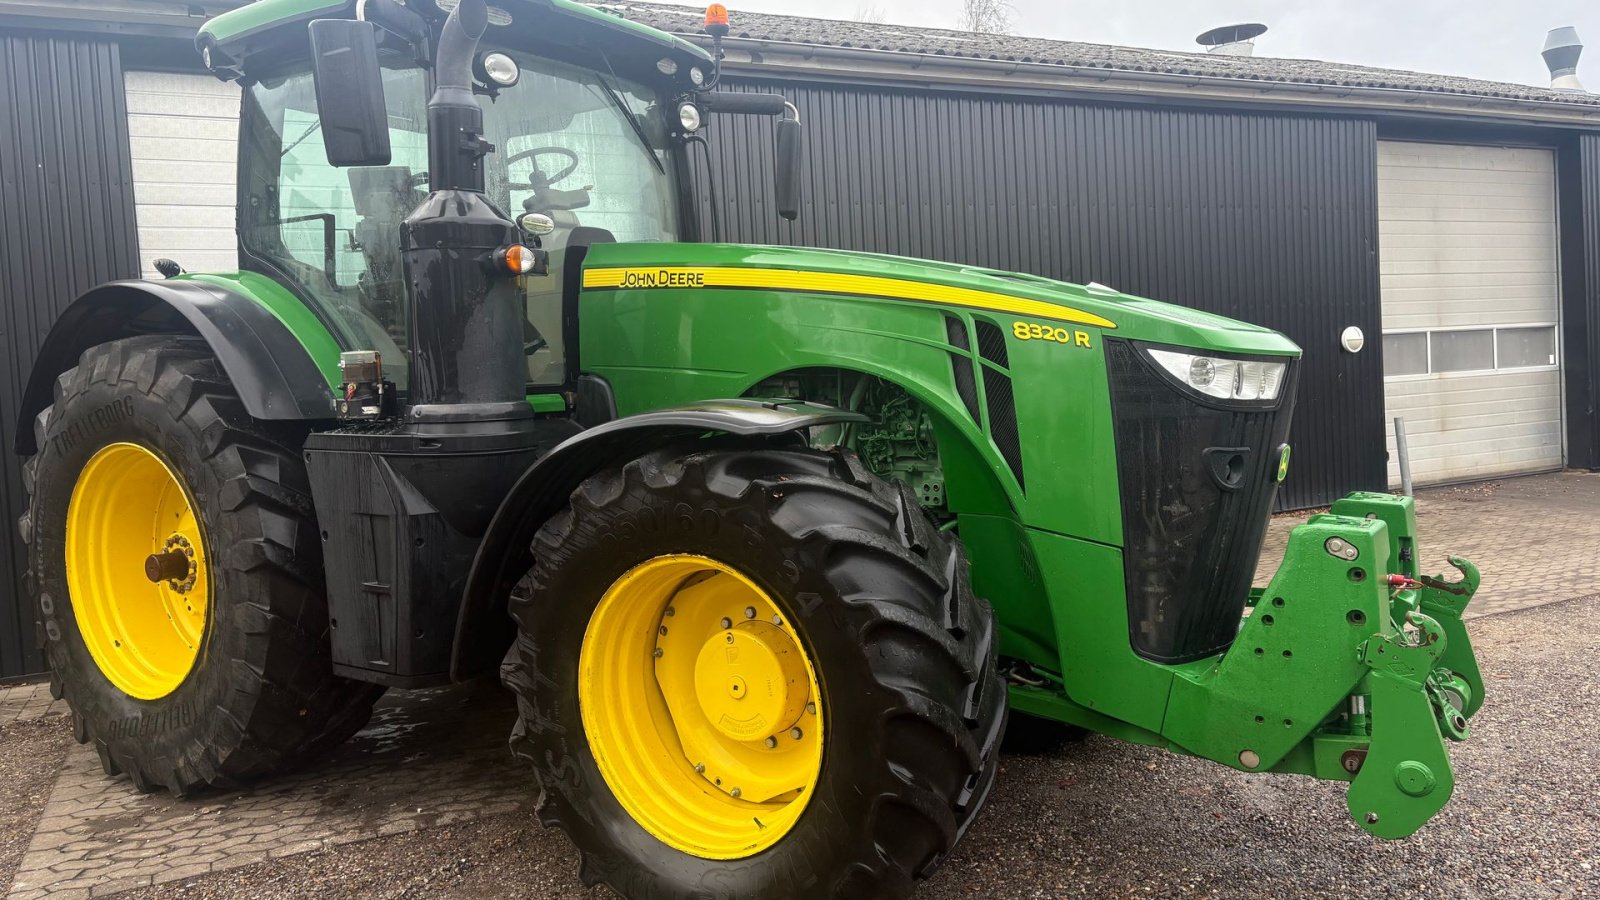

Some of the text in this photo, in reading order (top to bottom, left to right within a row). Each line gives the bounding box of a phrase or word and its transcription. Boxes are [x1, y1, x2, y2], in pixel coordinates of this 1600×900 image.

[620, 270, 704, 286] JOHN DEERE
[1013, 321, 1092, 349] 8320 R
[51, 394, 135, 457] TRELLEBORG
